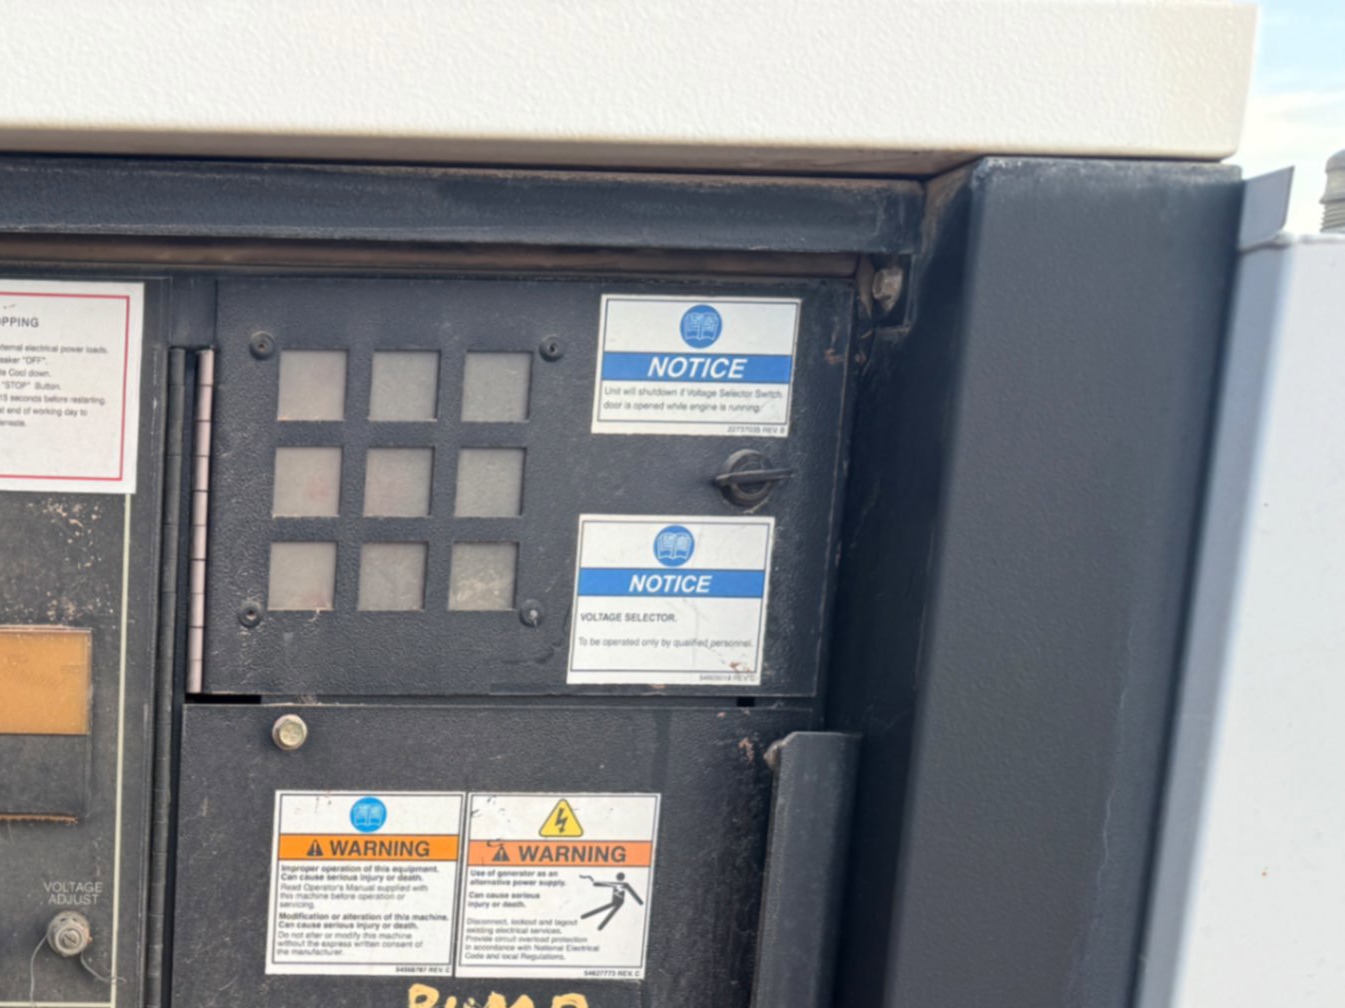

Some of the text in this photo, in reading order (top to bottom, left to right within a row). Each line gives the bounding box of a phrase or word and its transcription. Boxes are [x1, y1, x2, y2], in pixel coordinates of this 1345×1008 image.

[648, 357, 748, 379] NOTICE
[604, 386, 621, 395] Unit
[623, 386, 635, 395] will
[638, 387, 677, 396] shutdown
[679, 388, 685, 396] if
[686, 388, 716, 399] Voltage
[719, 388, 752, 398] Selector
[603, 400, 622, 409] door
[633, 401, 664, 410] opened
[666, 402, 687, 410] while
[689, 403, 717, 412] engine
[719, 403, 726, 411] is
[629, 575, 712, 593] NOTICE
[580, 612, 621, 621] VOLTAGE
[578, 636, 587, 646] To
[602, 638, 639, 646] operated
[641, 638, 659, 647] only
[661, 638, 671, 648] by
[673, 638, 707, 648] qualified
[330, 840, 430, 857] WARNING
[518, 845, 626, 863] WARNING
[281, 865, 318, 873] Improper
[43, 881, 103, 893] VOLTAGE
[48, 894, 99, 905] ADJUST
